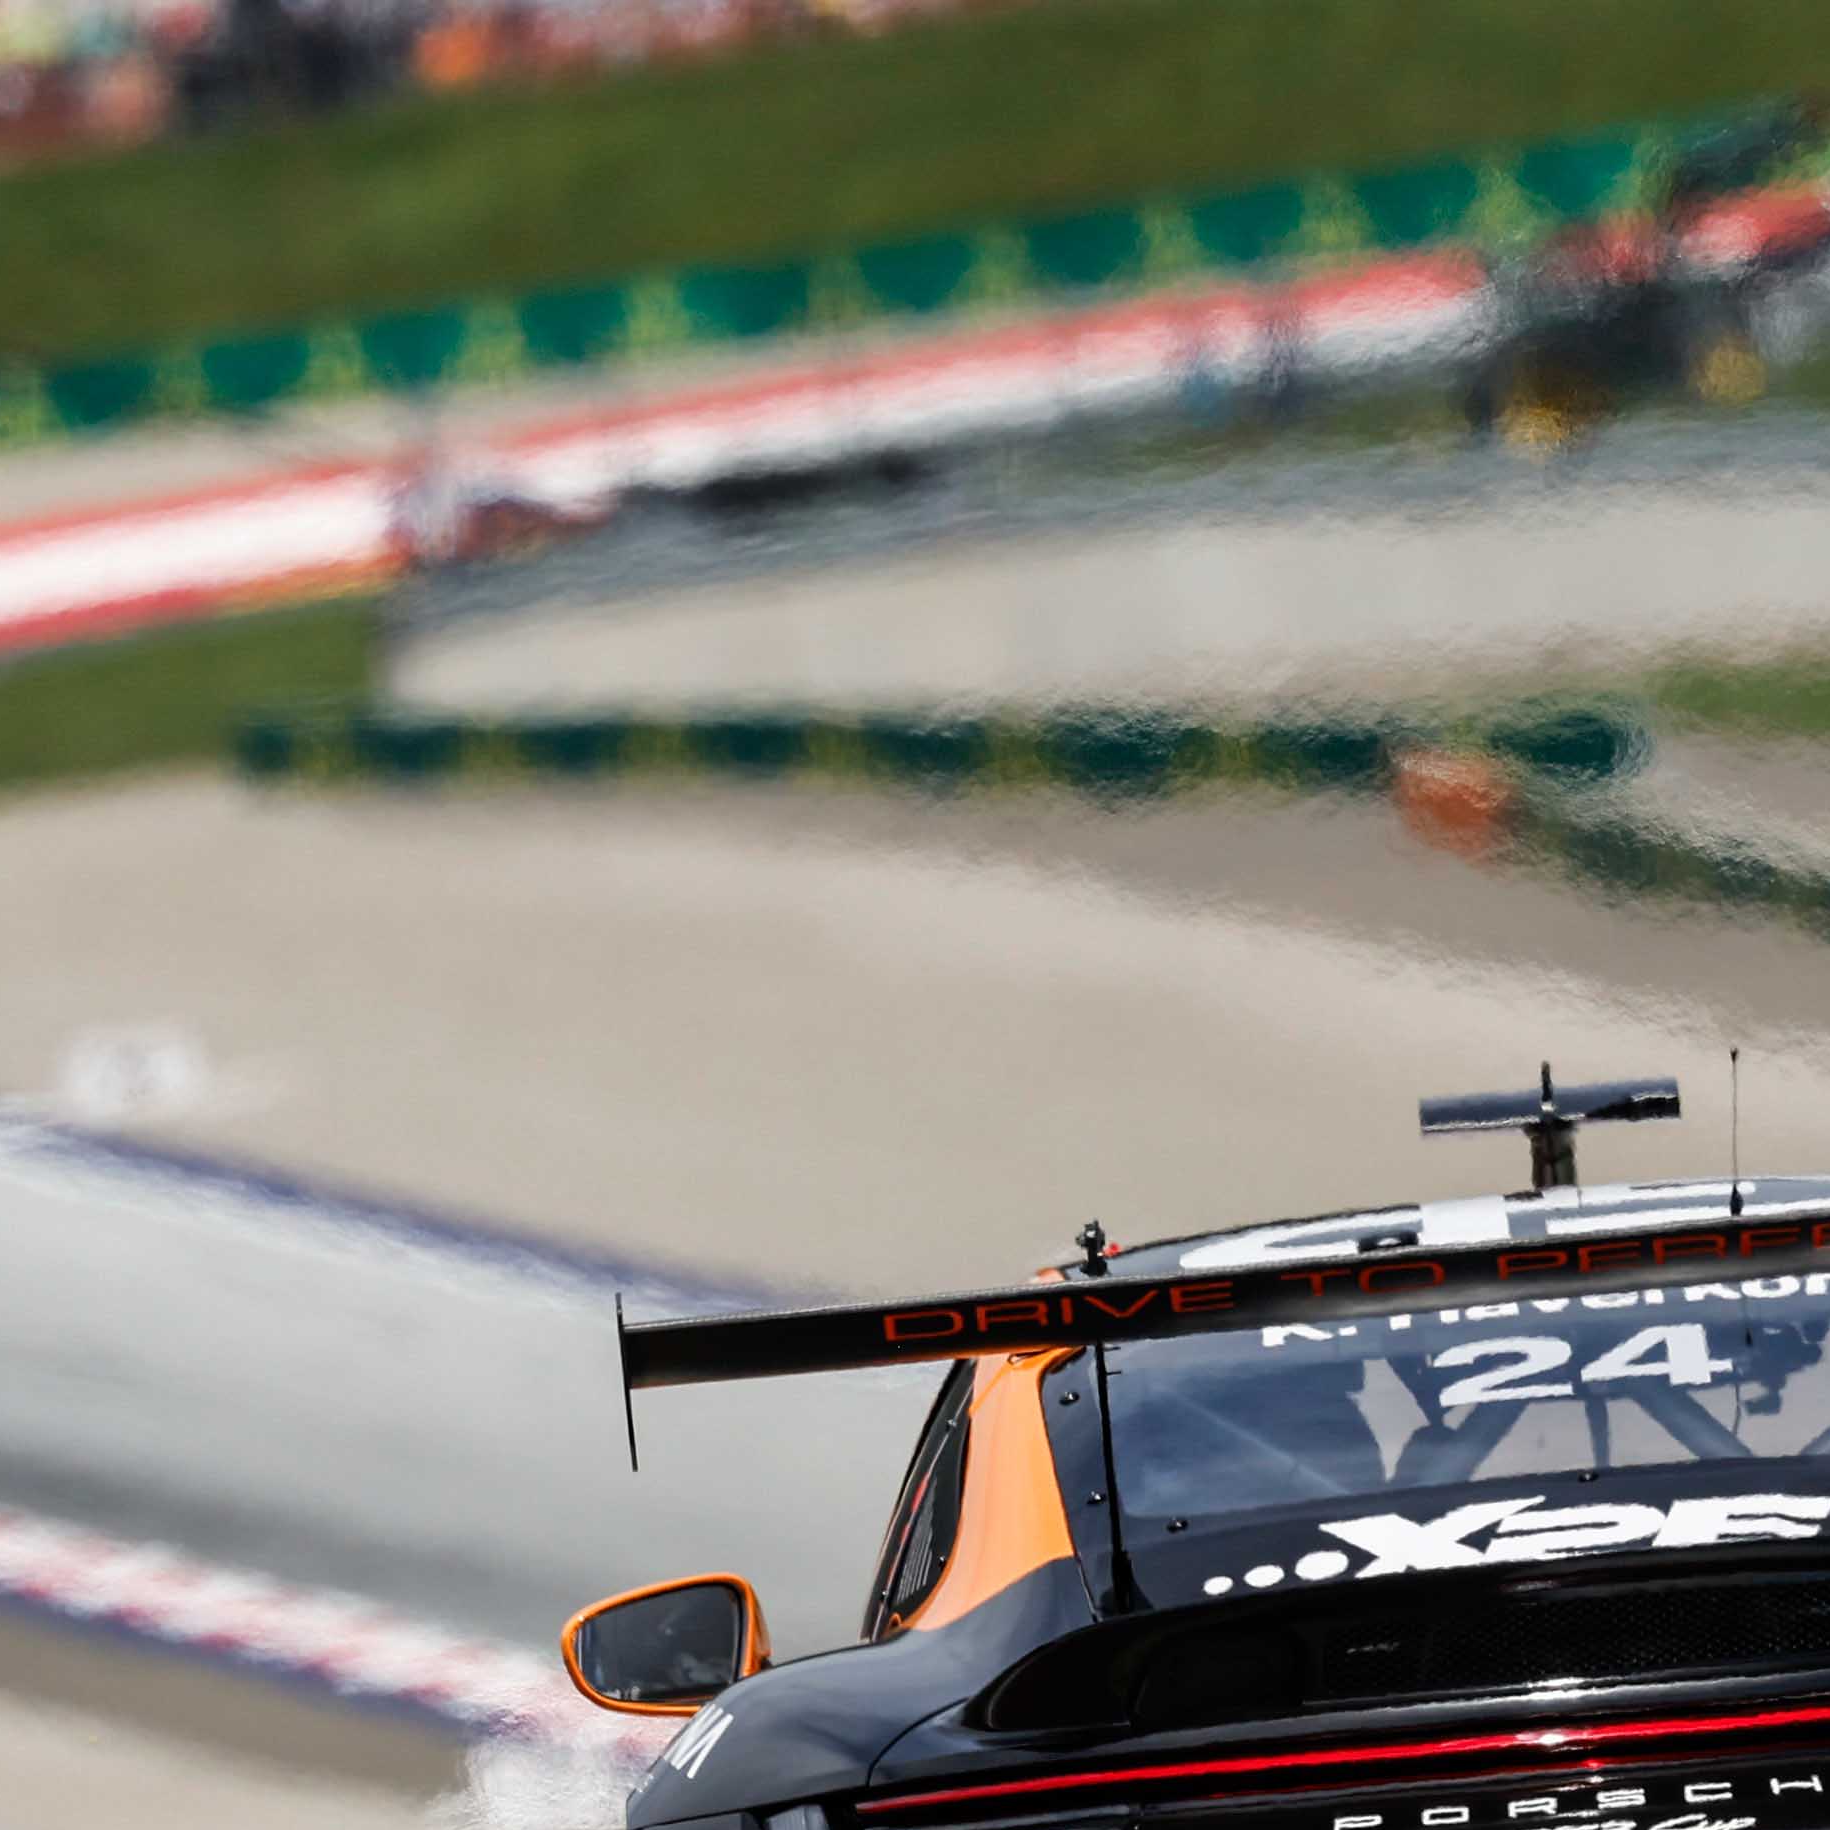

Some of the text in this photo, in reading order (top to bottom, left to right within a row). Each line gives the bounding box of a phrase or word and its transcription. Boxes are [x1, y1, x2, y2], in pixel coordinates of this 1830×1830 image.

[883, 1281, 1234, 1342] DRIVE
[1280, 1260, 1446, 1297] TO
[1432, 1323, 1733, 1408] 24
